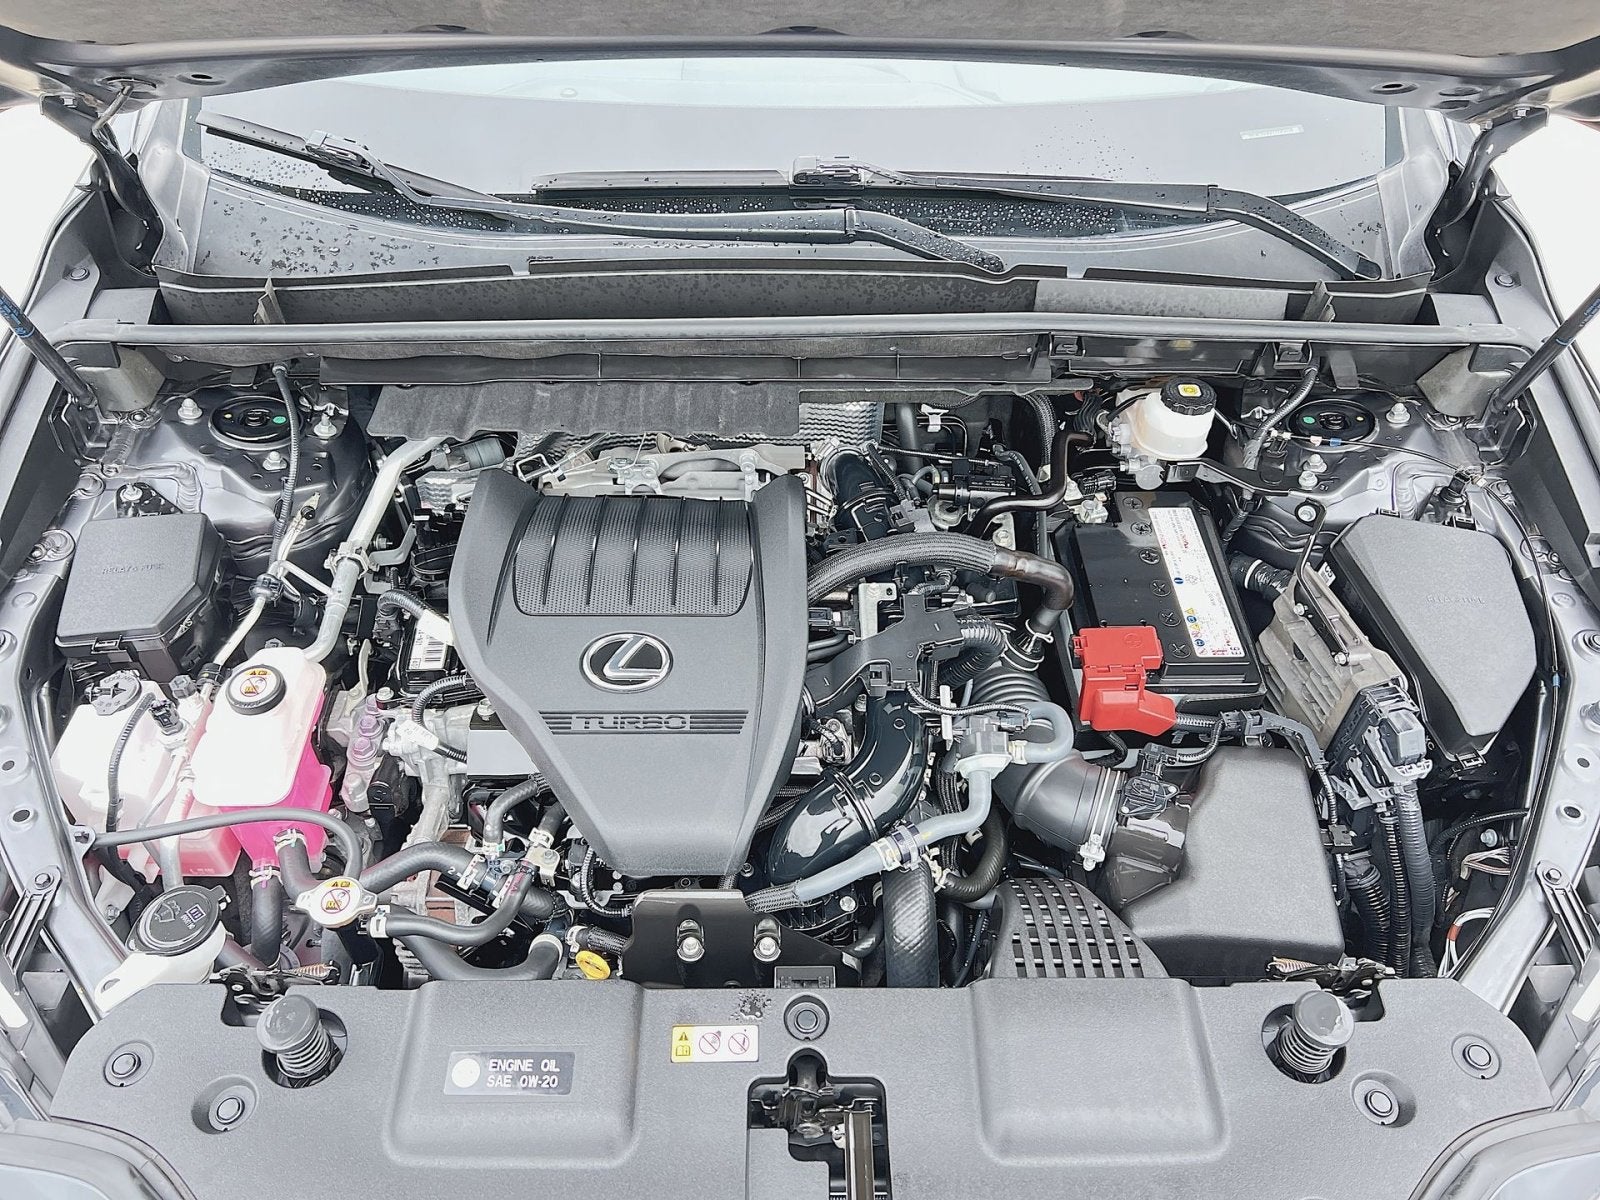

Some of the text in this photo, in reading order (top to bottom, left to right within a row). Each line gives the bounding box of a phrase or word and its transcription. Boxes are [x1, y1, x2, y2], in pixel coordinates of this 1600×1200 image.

[575, 714, 686, 729] TURBO
[488, 1058, 560, 1072] ENGINE OIL
[486, 1075, 512, 1088] SAE
